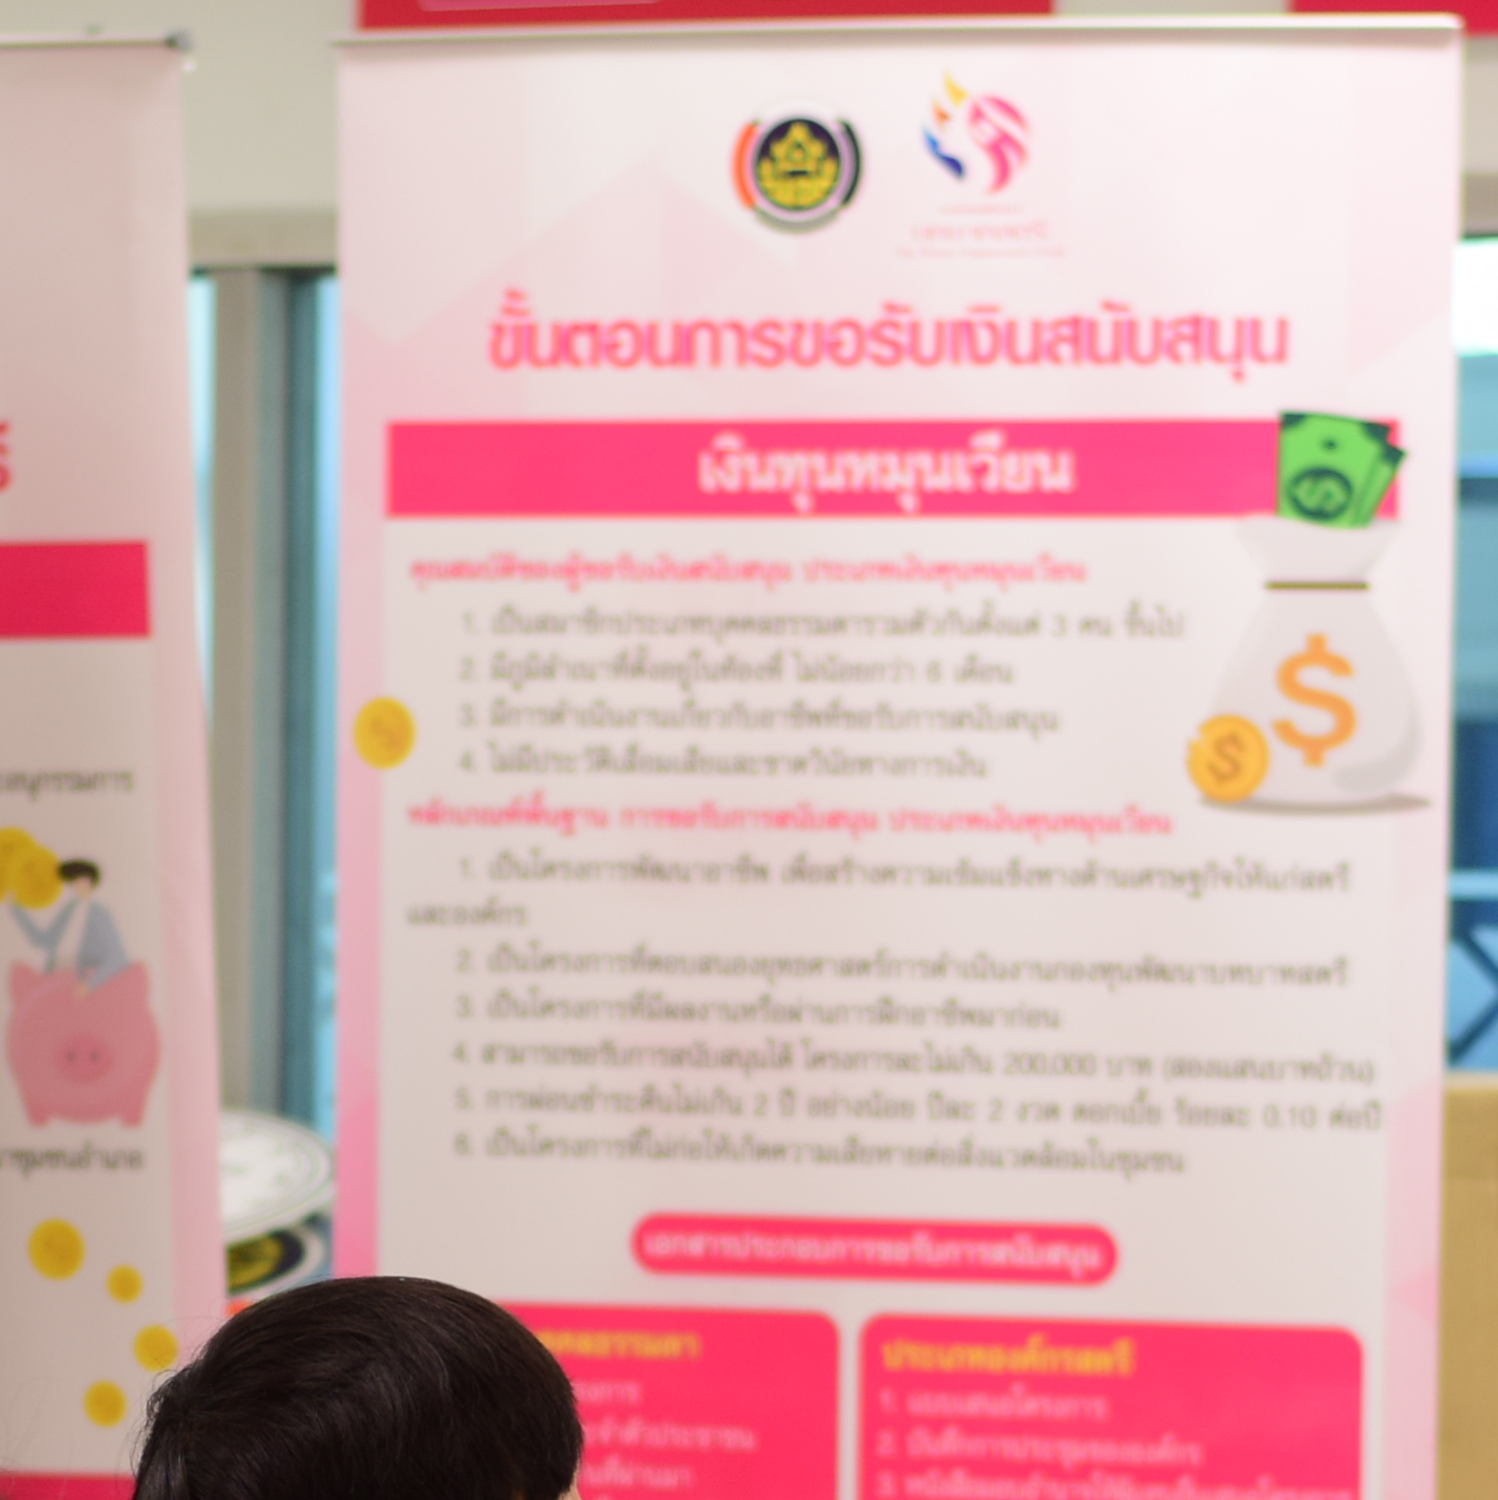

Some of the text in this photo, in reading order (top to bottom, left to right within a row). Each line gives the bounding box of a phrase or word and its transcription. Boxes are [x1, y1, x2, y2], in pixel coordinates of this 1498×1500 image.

[488, 290, 1290, 382] ขั้นตอนการขอรับเงินสนับสนุน
[698, 436, 1075, 512] เงินทุนหมุนเวียน
